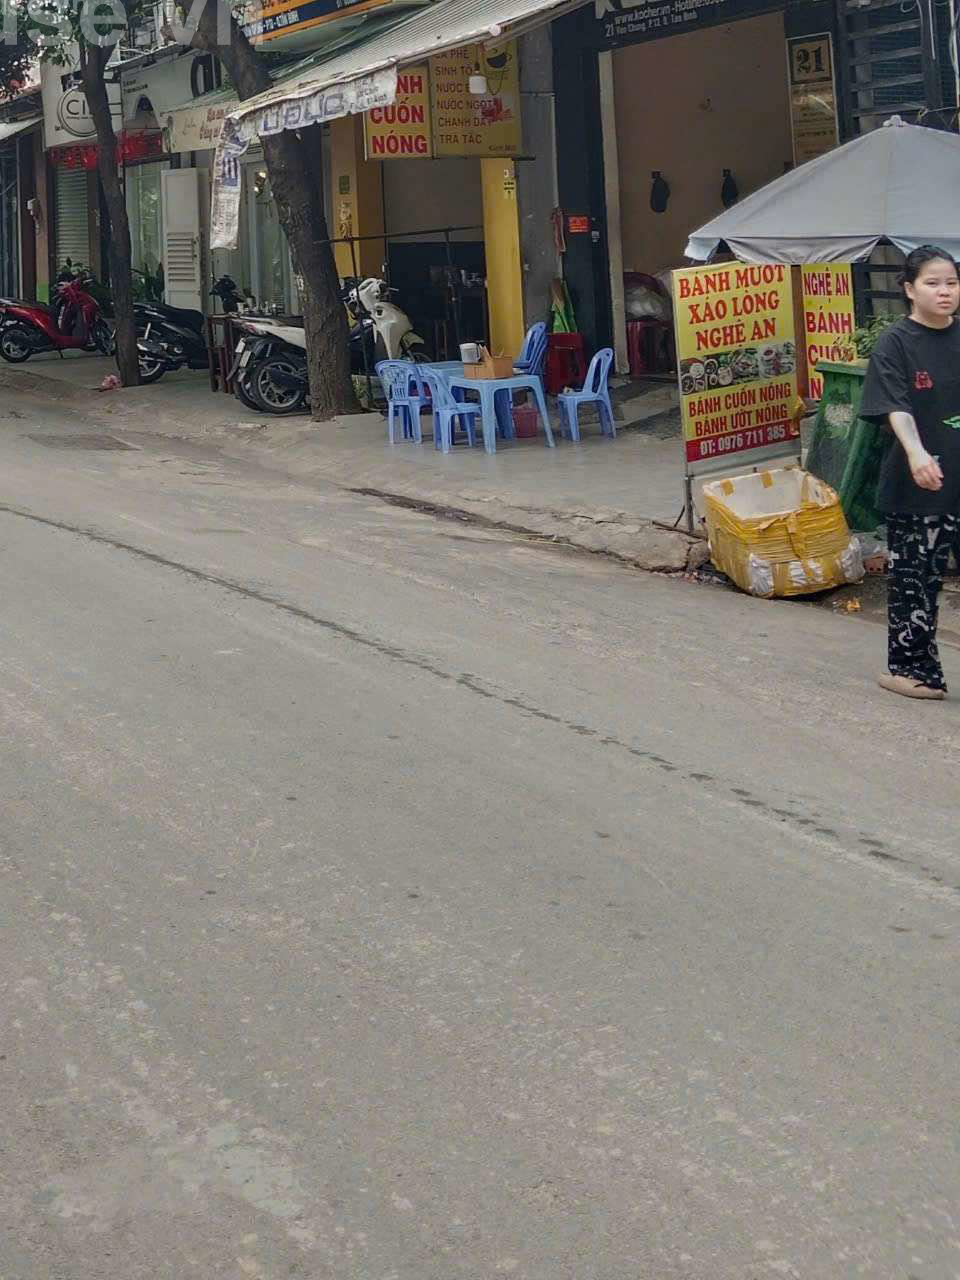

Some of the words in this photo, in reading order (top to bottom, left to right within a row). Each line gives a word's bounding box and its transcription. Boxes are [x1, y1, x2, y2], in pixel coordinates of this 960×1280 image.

[797, 46, 825, 74] 21
[370, 97, 425, 125] CUỐN
[372, 130, 428, 154] NÓNG
[679, 271, 730, 298] BÁNH
[804, 267, 832, 304] NGHỆ
[835, 272, 849, 296] AN
[689, 296, 727, 324] XÁO
[732, 289, 780, 317] LÒNG
[806, 305, 852, 334] BÁNH
[696, 319, 746, 351] NGHỆ
[750, 317, 777, 341] AN
[688, 396, 721, 417] BÁNH
[724, 385, 756, 410] CUỐN
[760, 382, 791, 403] NÓNG
[695, 415, 728, 437] BÁNH
[756, 403, 788, 424] NÓNG
[718, 433, 744, 451] 0976
[746, 429, 764, 446] 711
